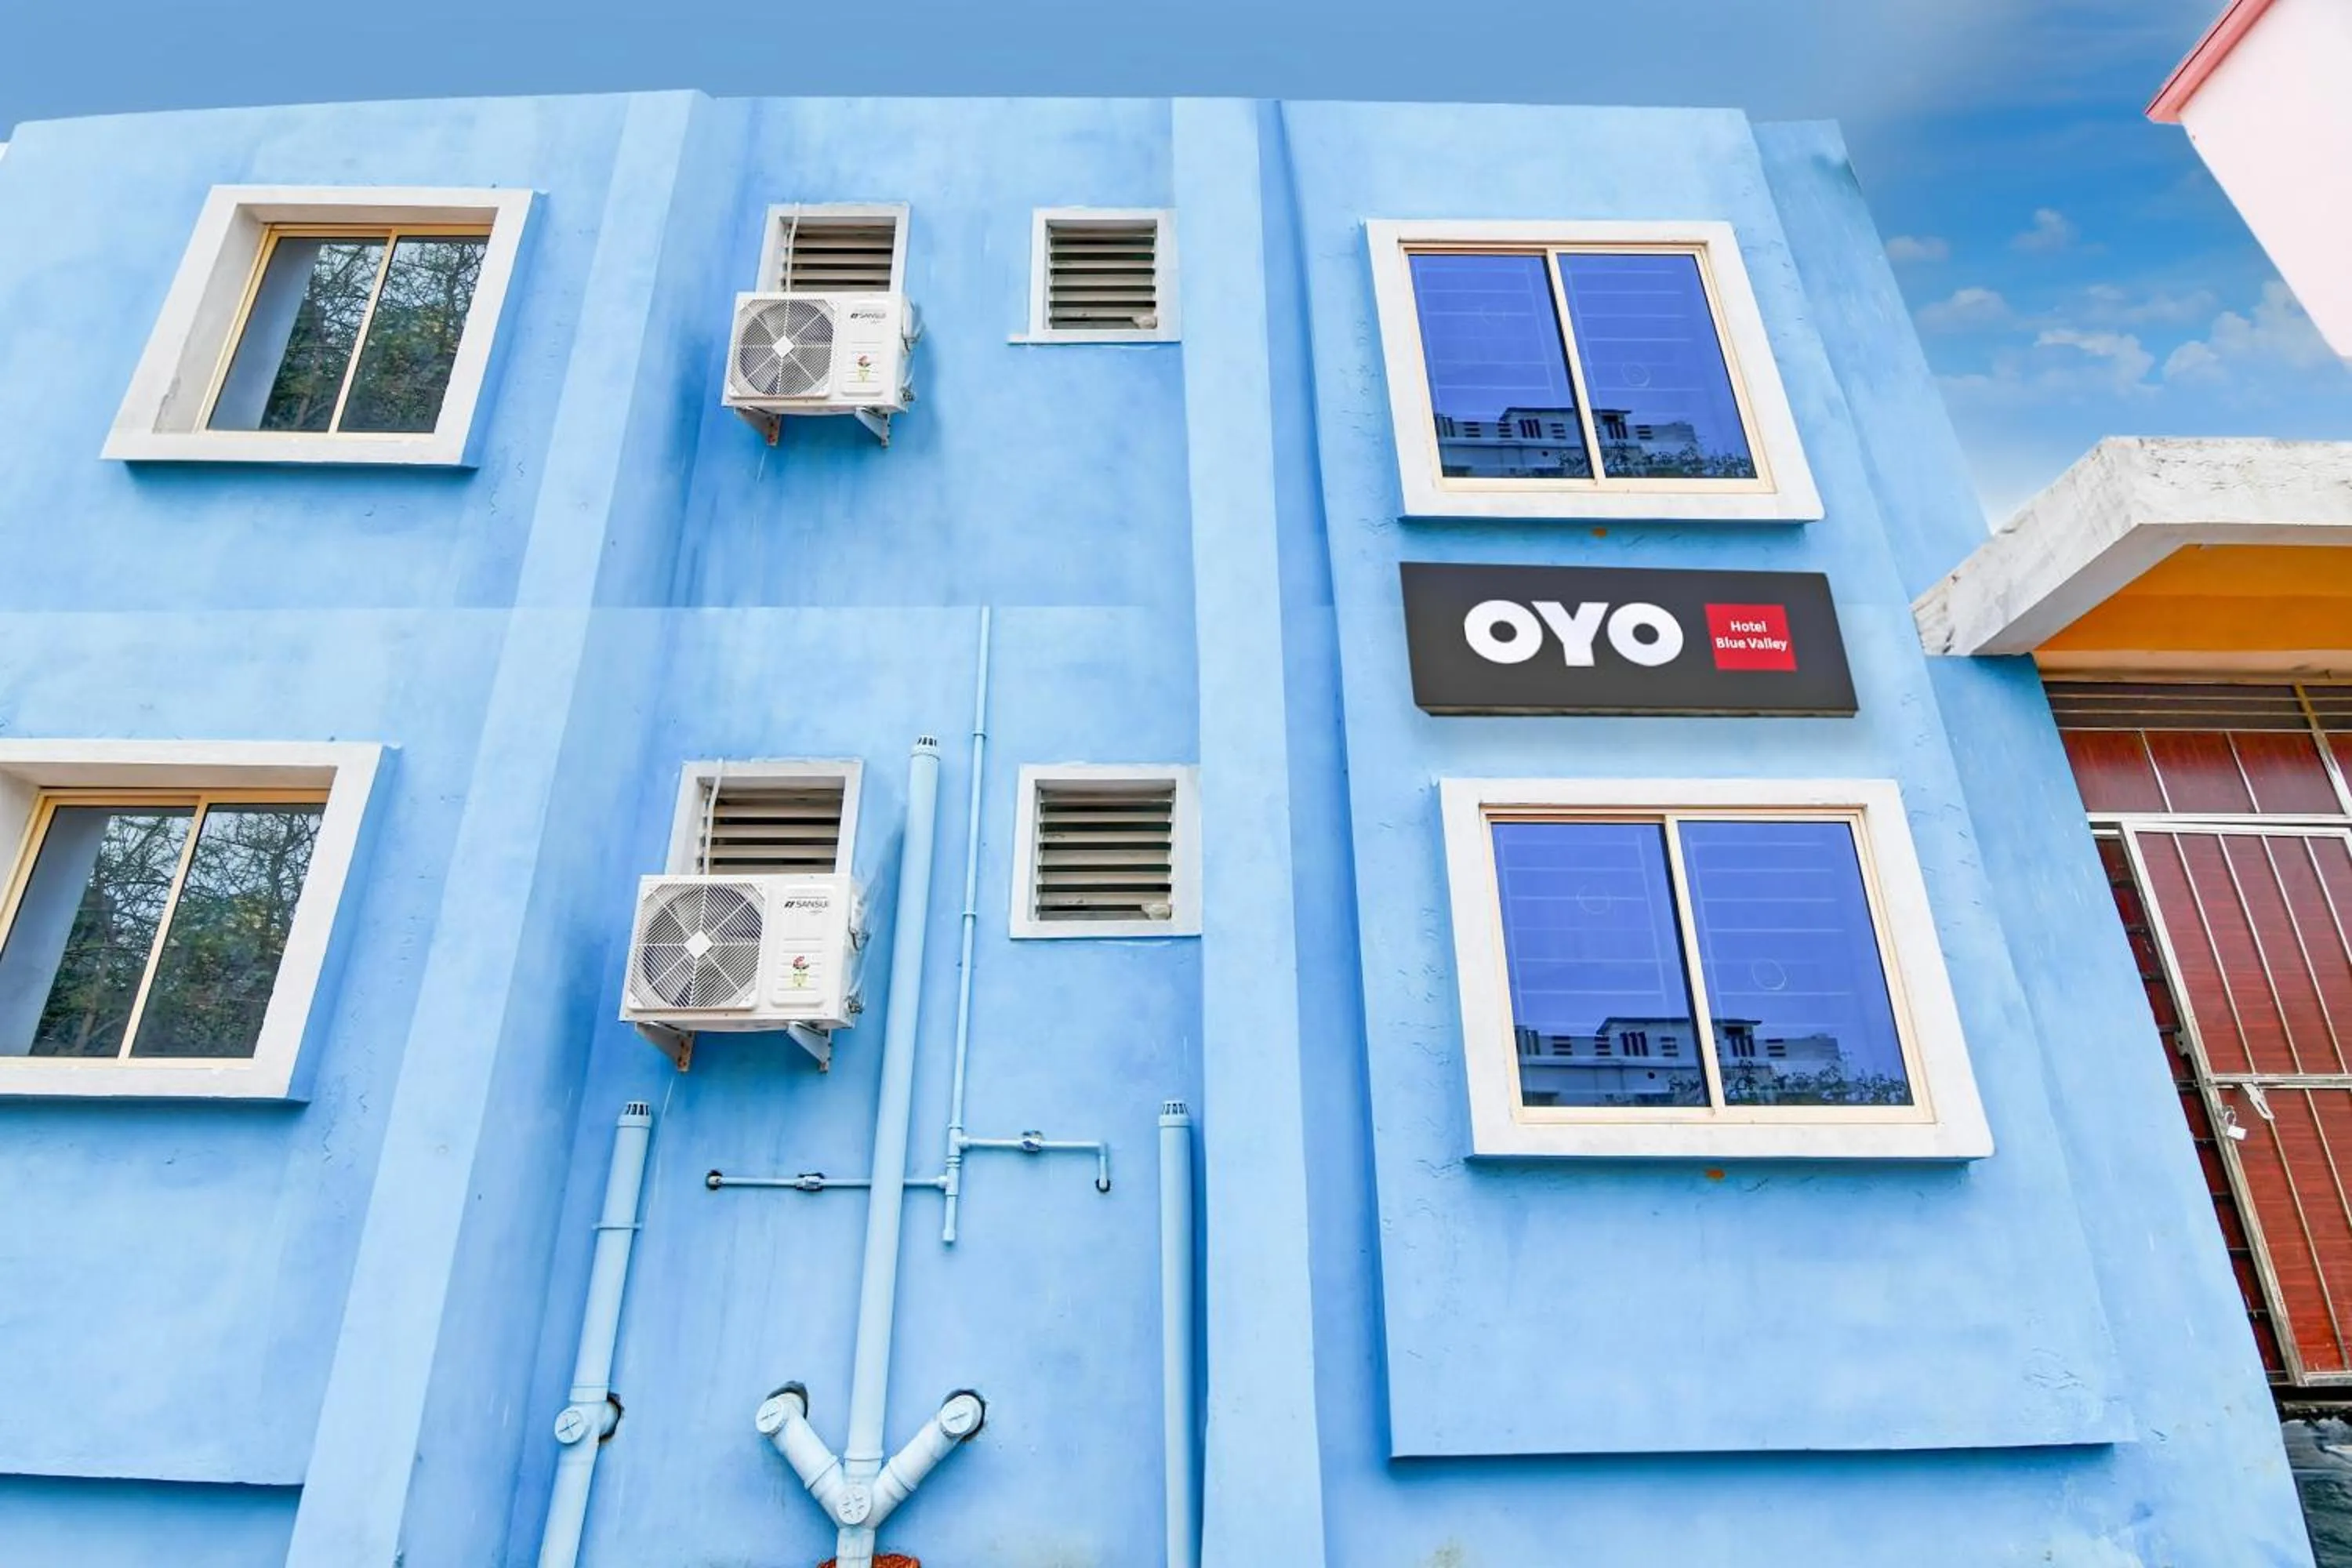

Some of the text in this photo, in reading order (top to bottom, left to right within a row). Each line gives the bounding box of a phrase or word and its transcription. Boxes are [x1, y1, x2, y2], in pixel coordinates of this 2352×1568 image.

[1464, 600, 1683, 666] OYO
[1730, 621, 1767, 632] Hotel
[1715, 637, 1788, 652] Blue Valley
